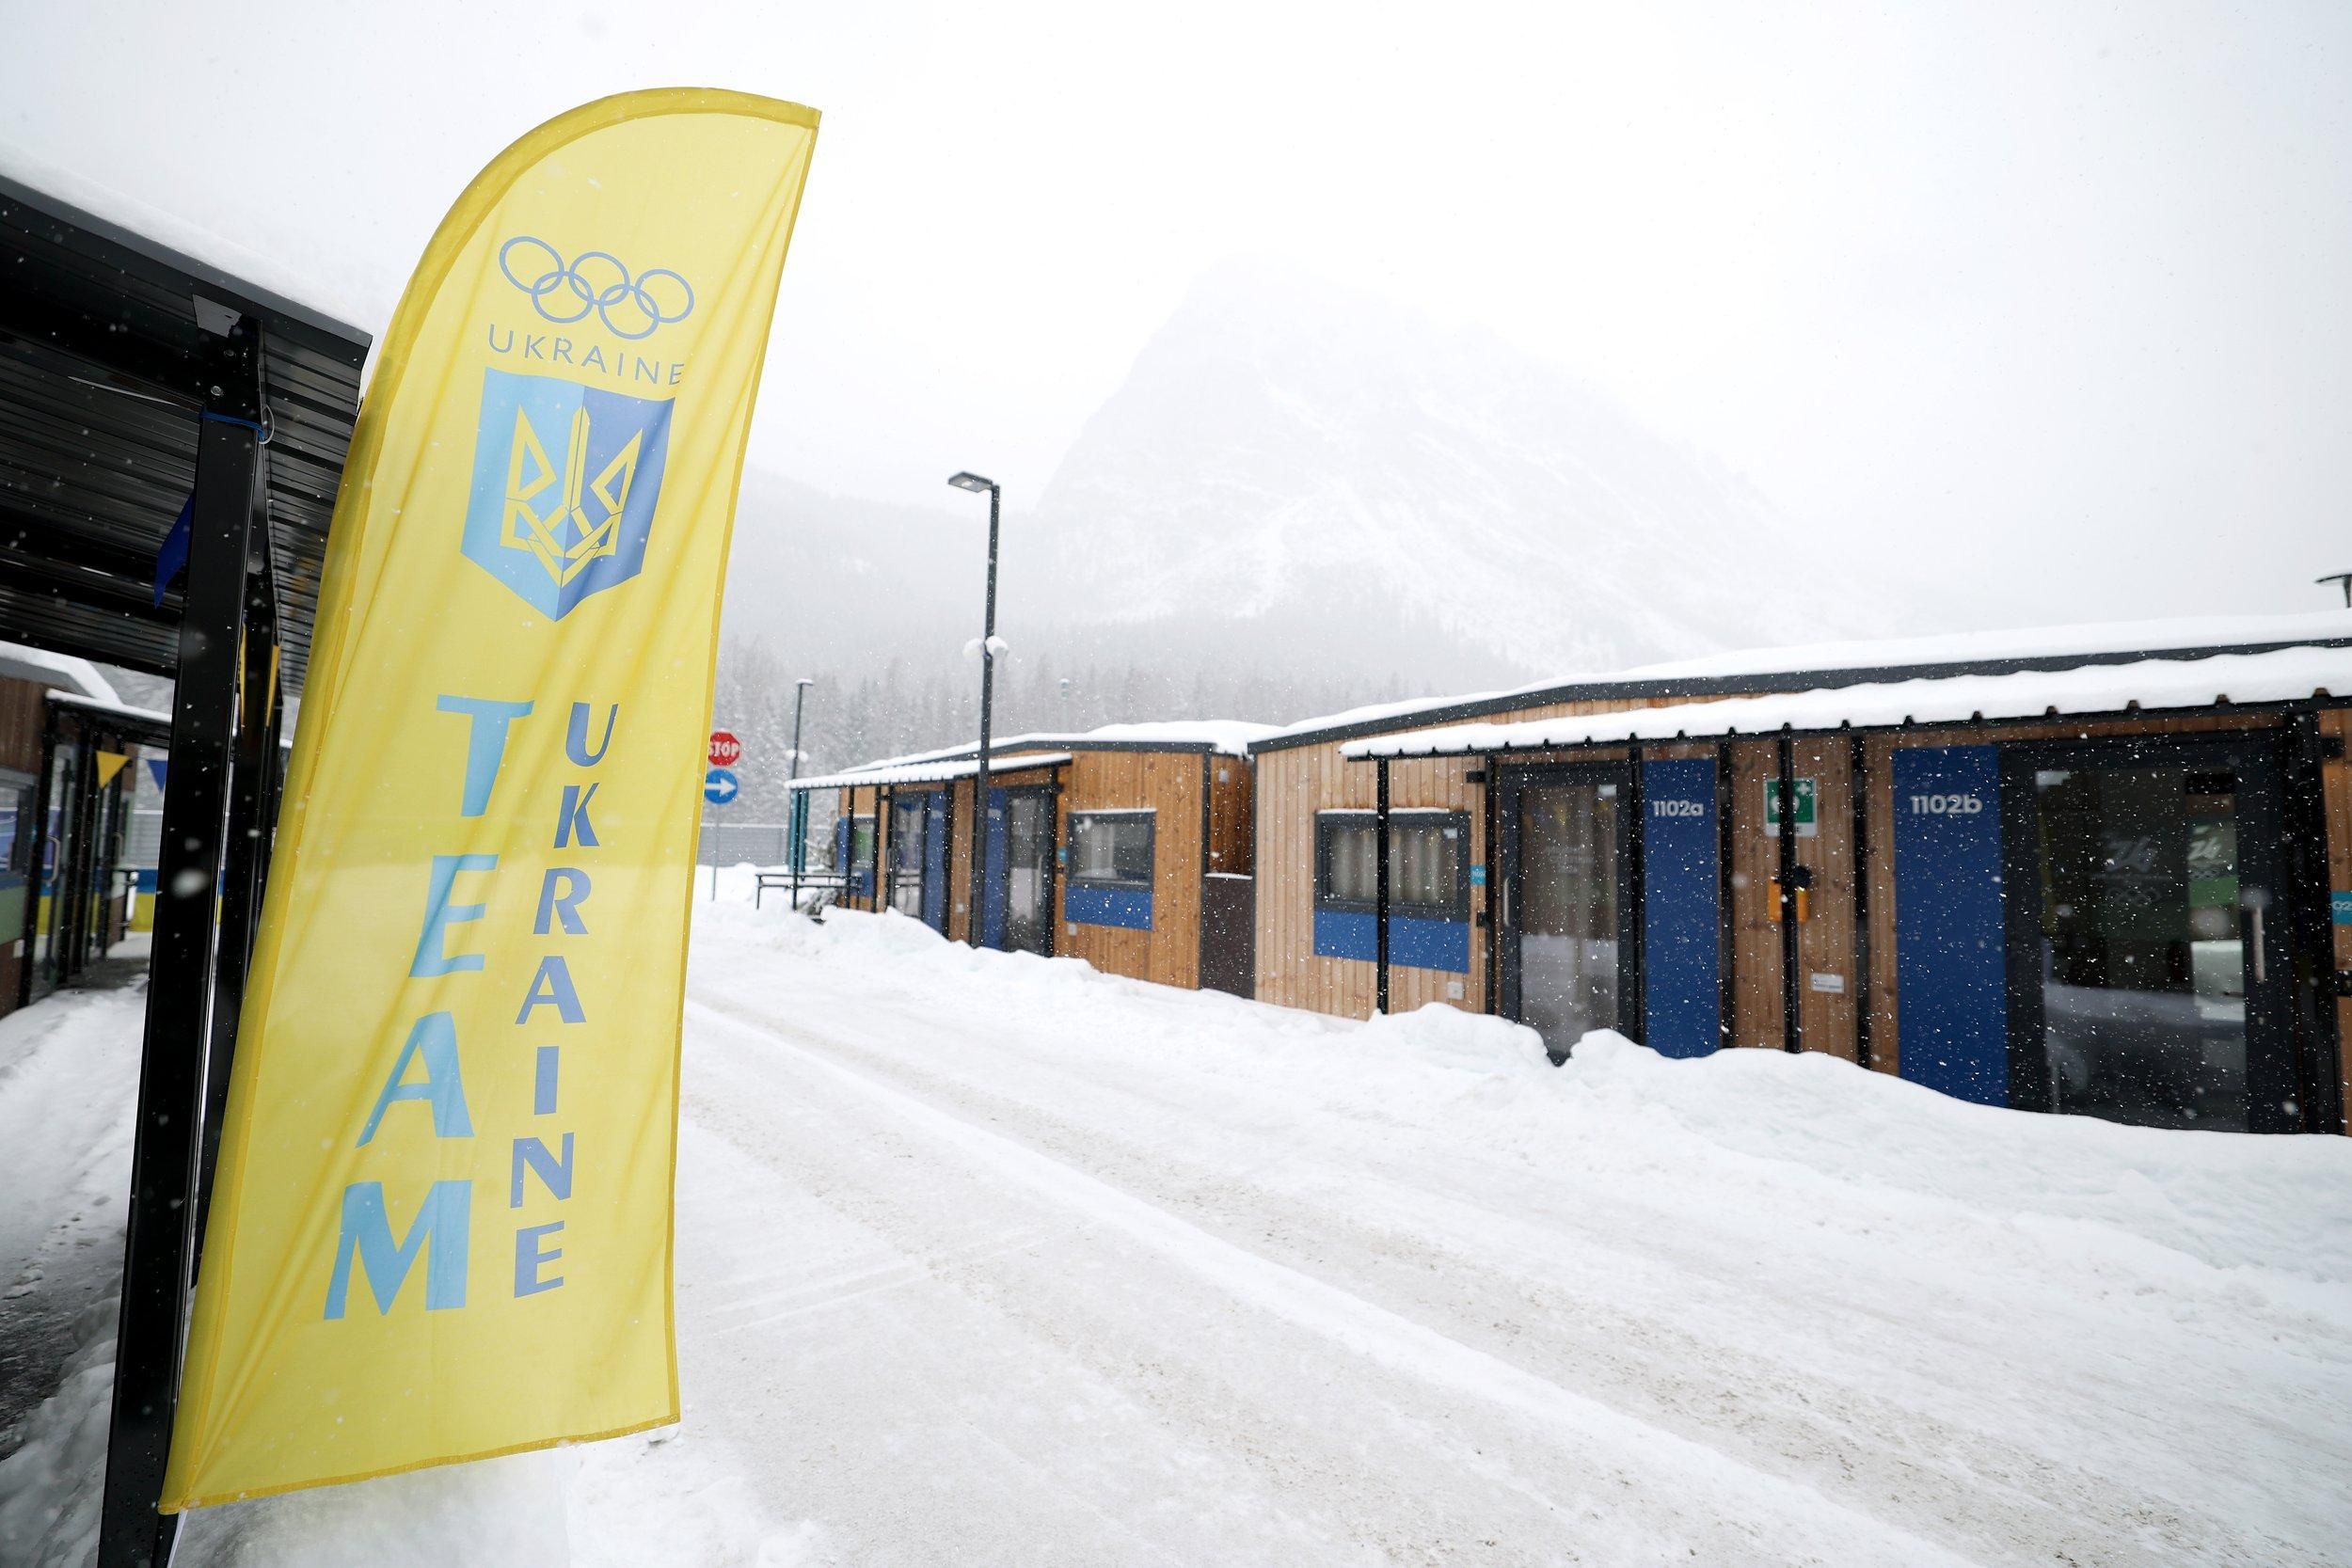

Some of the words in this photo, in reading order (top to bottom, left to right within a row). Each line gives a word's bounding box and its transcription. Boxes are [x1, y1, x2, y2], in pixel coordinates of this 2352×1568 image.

[487, 324, 685, 386] UKRAINE
[708, 740, 739, 757] STOP
[1652, 800, 1704, 816] 1102a
[1909, 794, 1983, 814] 1102b
[323, 694, 534, 1321] TEAM
[510, 702, 618, 1299] UKRAINE
